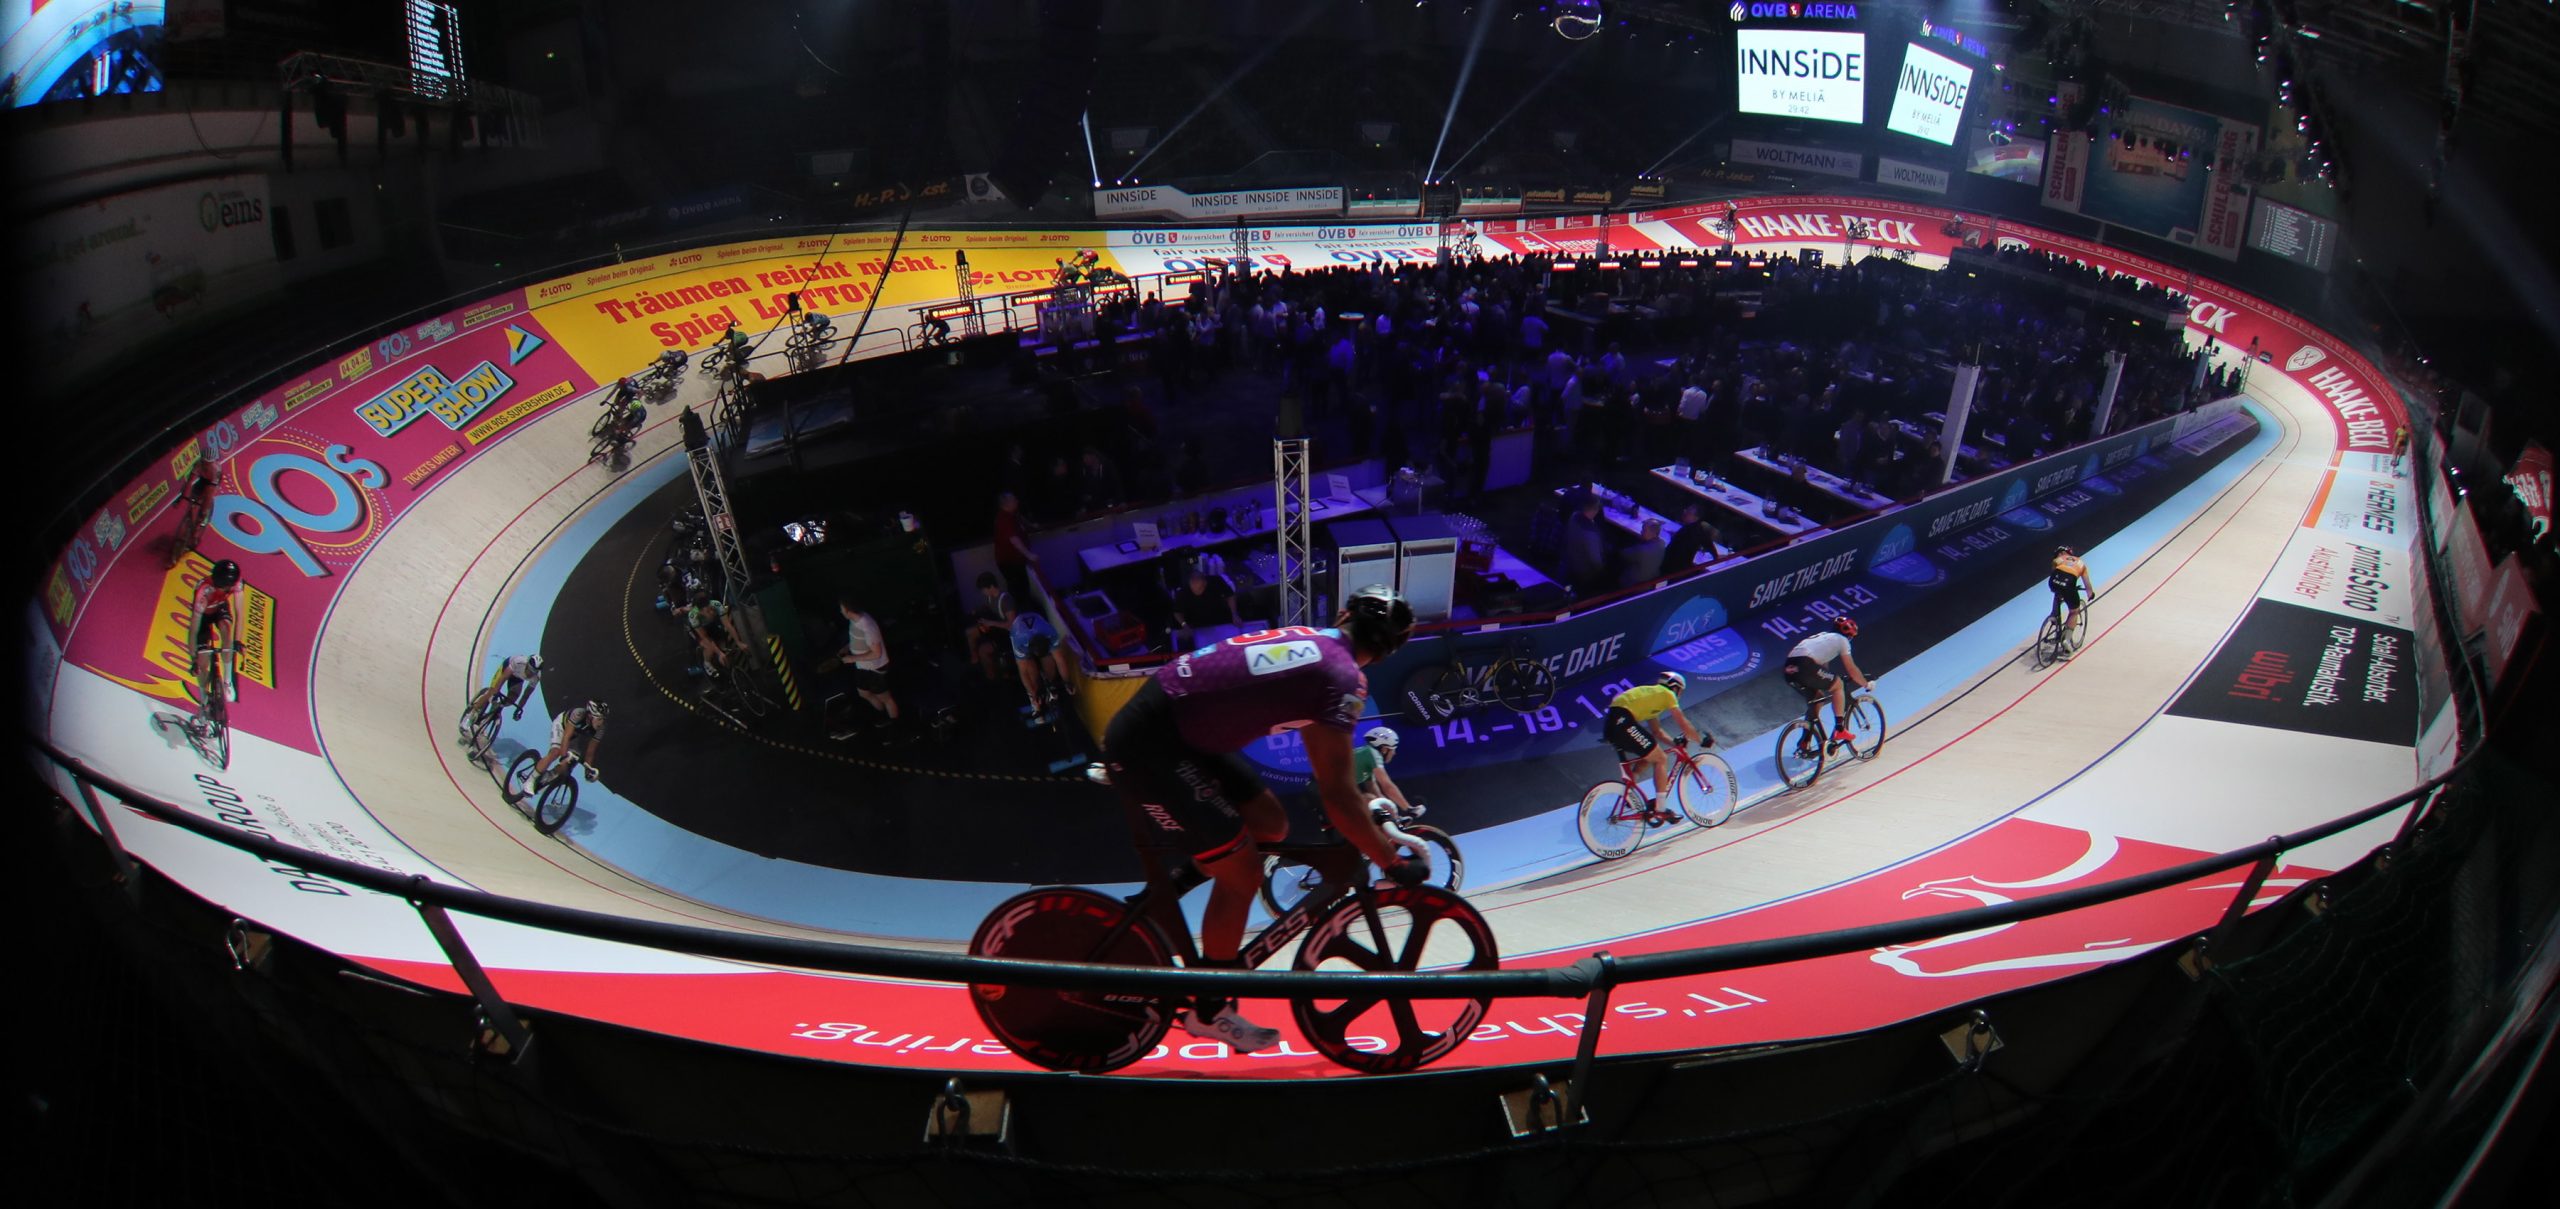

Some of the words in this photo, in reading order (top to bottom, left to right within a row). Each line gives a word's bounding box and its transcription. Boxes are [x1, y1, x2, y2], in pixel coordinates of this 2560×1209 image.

[1804, 4, 1857, 19] ARENA
[1741, 48, 1861, 82] INNSiDE
[1756, 147, 1836, 169] WOLTMANN
[1894, 166, 1937, 187] WOLTMANN
[806, 240, 829, 248] LOTTO
[1132, 230, 1166, 244] ÖVB
[1318, 226, 1346, 239] ÖVB
[1398, 224, 1424, 237] ÖVB
[678, 253, 703, 265] LOTTO
[1331, 249, 1415, 262] ÖVB
[548, 282, 572, 296] LOTTO
[595, 275, 752, 325] Träumen
[756, 260, 852, 289] reicht
[857, 255, 947, 276] nicht.
[998, 268, 1060, 283] LOTT
[650, 305, 741, 348] Spiel
[363, 371, 447, 430] SUPER
[432, 366, 503, 423] SHOW
[2308, 366, 2390, 449] HAAKE-BECK
[469, 386, 568, 441] WWW.90S-SUPERSHOW.DE
[402, 458, 434, 487] TICKETS
[432, 443, 462, 468] UNTER
[1928, 514, 1955, 538] SAVE
[1953, 505, 1972, 527] THE
[1968, 497, 1993, 523] DATE
[2362, 487, 2396, 535] HERMES
[1749, 572, 1796, 609] SAVE
[1792, 561, 1823, 592] THE
[1819, 548, 1858, 581] DATE
[2295, 545, 2340, 600] Akustikbilder
[2342, 542, 2391, 612] primaSono
[248, 591, 266, 631] BREMEN
[246, 629, 264, 661] ARENA
[1665, 615, 1700, 644] SIX
[1563, 631, 1627, 679] DATE
[1668, 634, 1728, 662] DAYS
[2302, 625, 2359, 706] TOP-Raumakustik.
[2362, 633, 2399, 703] Schall-Absorber.
[1407, 690, 1431, 721] CORIMA
[1626, 724, 1652, 749] SUISSE
